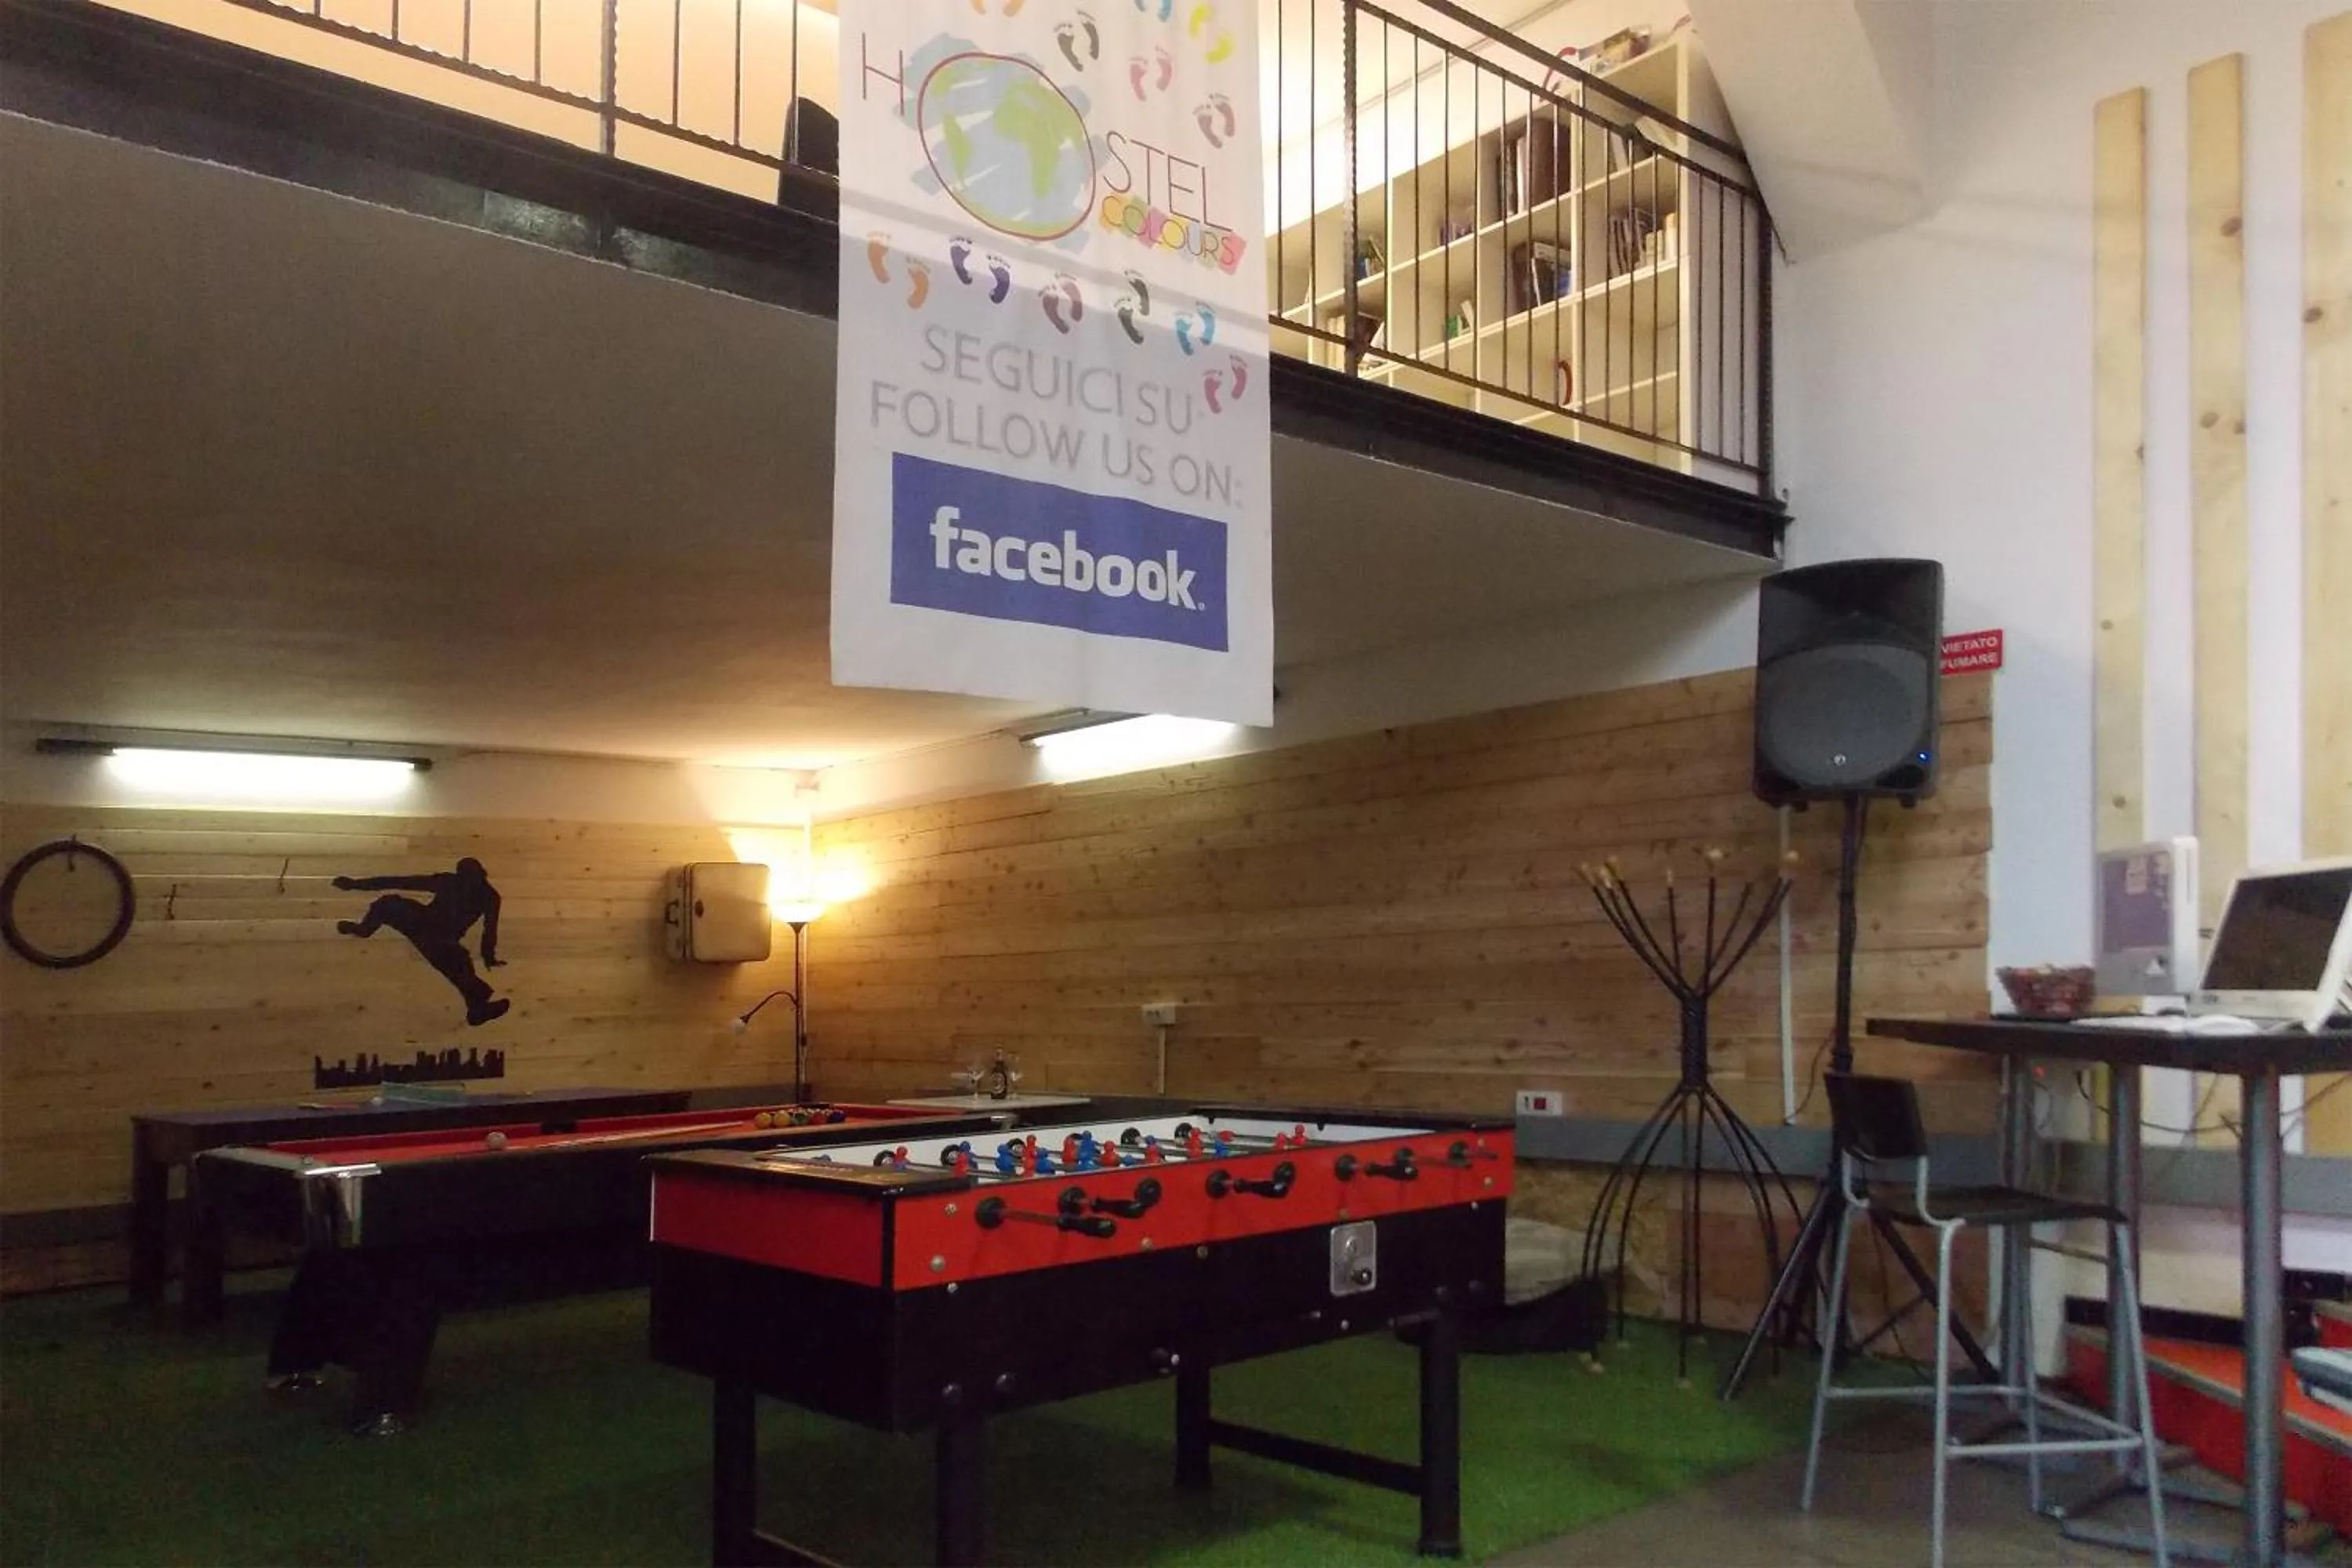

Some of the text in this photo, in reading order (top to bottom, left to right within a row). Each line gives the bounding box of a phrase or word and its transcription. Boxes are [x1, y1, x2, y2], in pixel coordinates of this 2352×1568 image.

[1102, 195, 1236, 266] COLOURS
[920, 324, 1123, 419] SEGUICI
[870, 379, 1085, 471] FOLLOW
[1102, 434, 1153, 485] US
[1941, 636, 1998, 653] VIETATO
